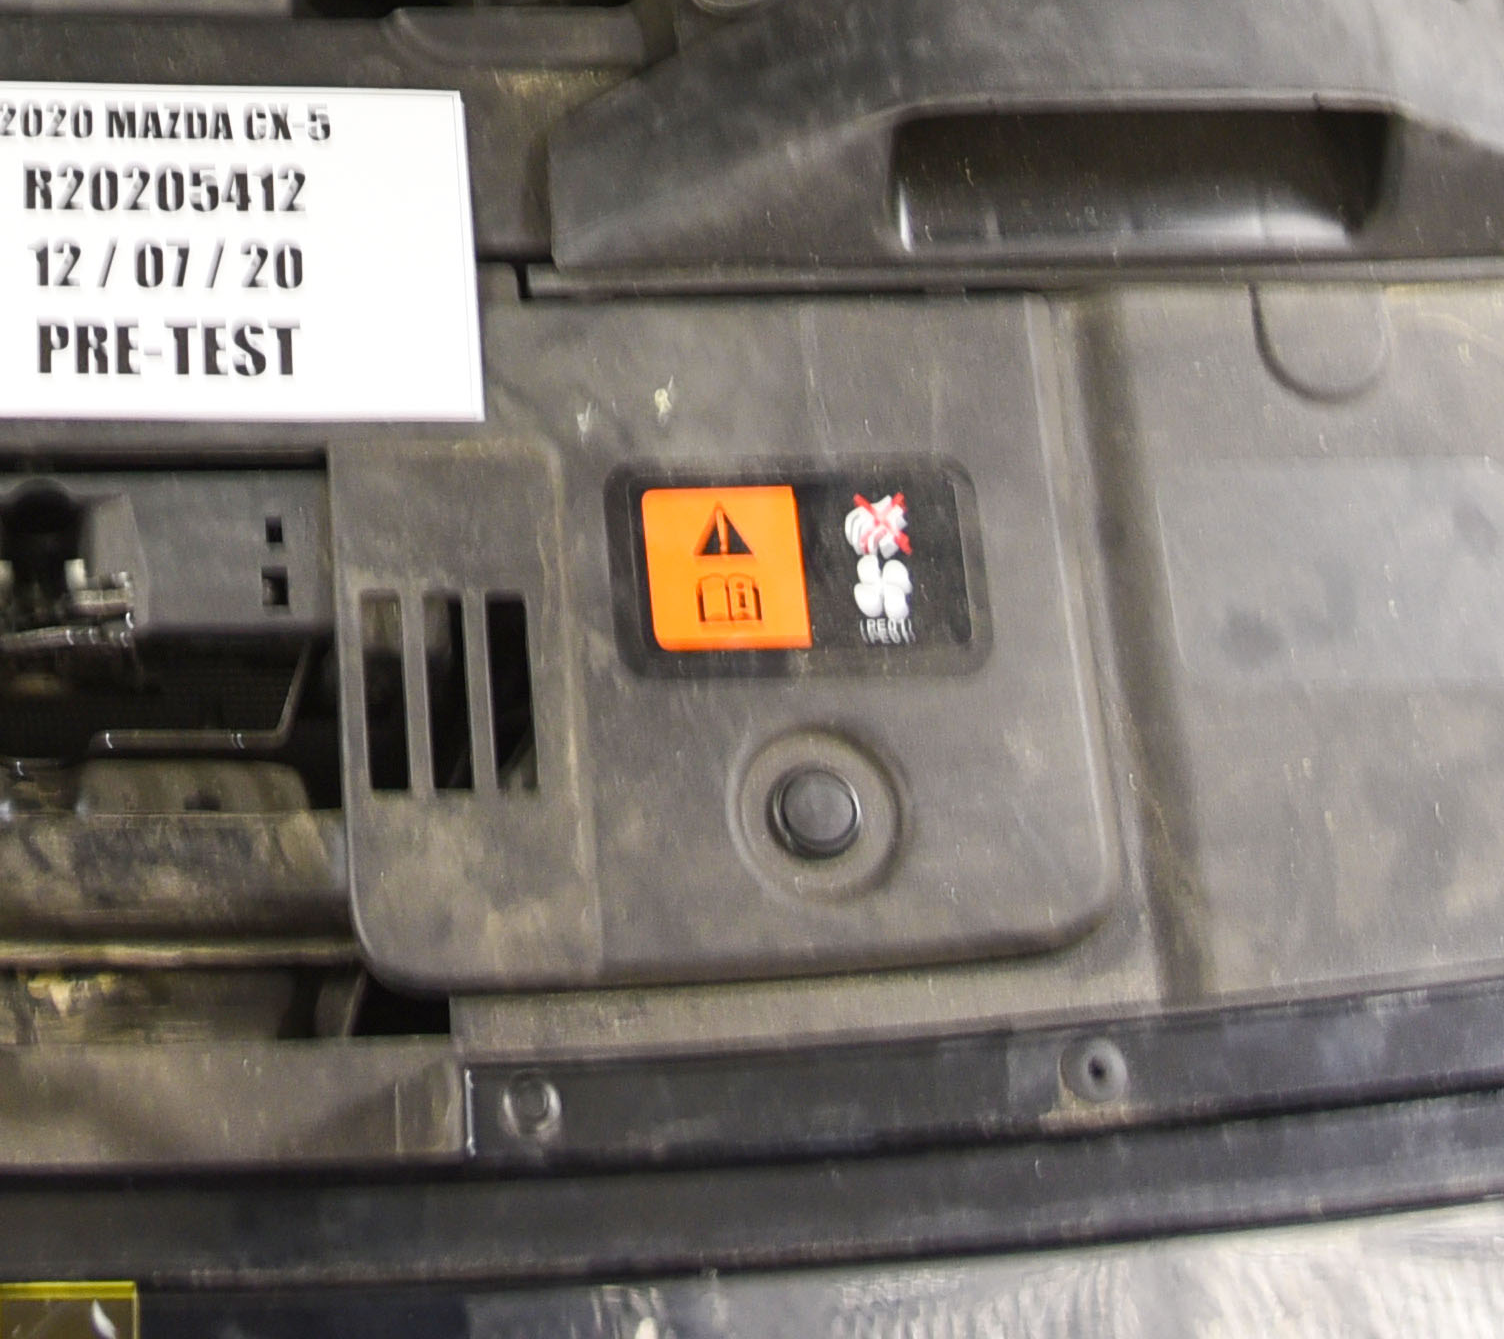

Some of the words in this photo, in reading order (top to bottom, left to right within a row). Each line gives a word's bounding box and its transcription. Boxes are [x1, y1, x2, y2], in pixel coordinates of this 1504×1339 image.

[104, 100, 234, 139] MAZDA
[243, 101, 332, 141] CX-5
[22, 159, 306, 212] R20205412
[36, 315, 301, 377] PRE-TEST
